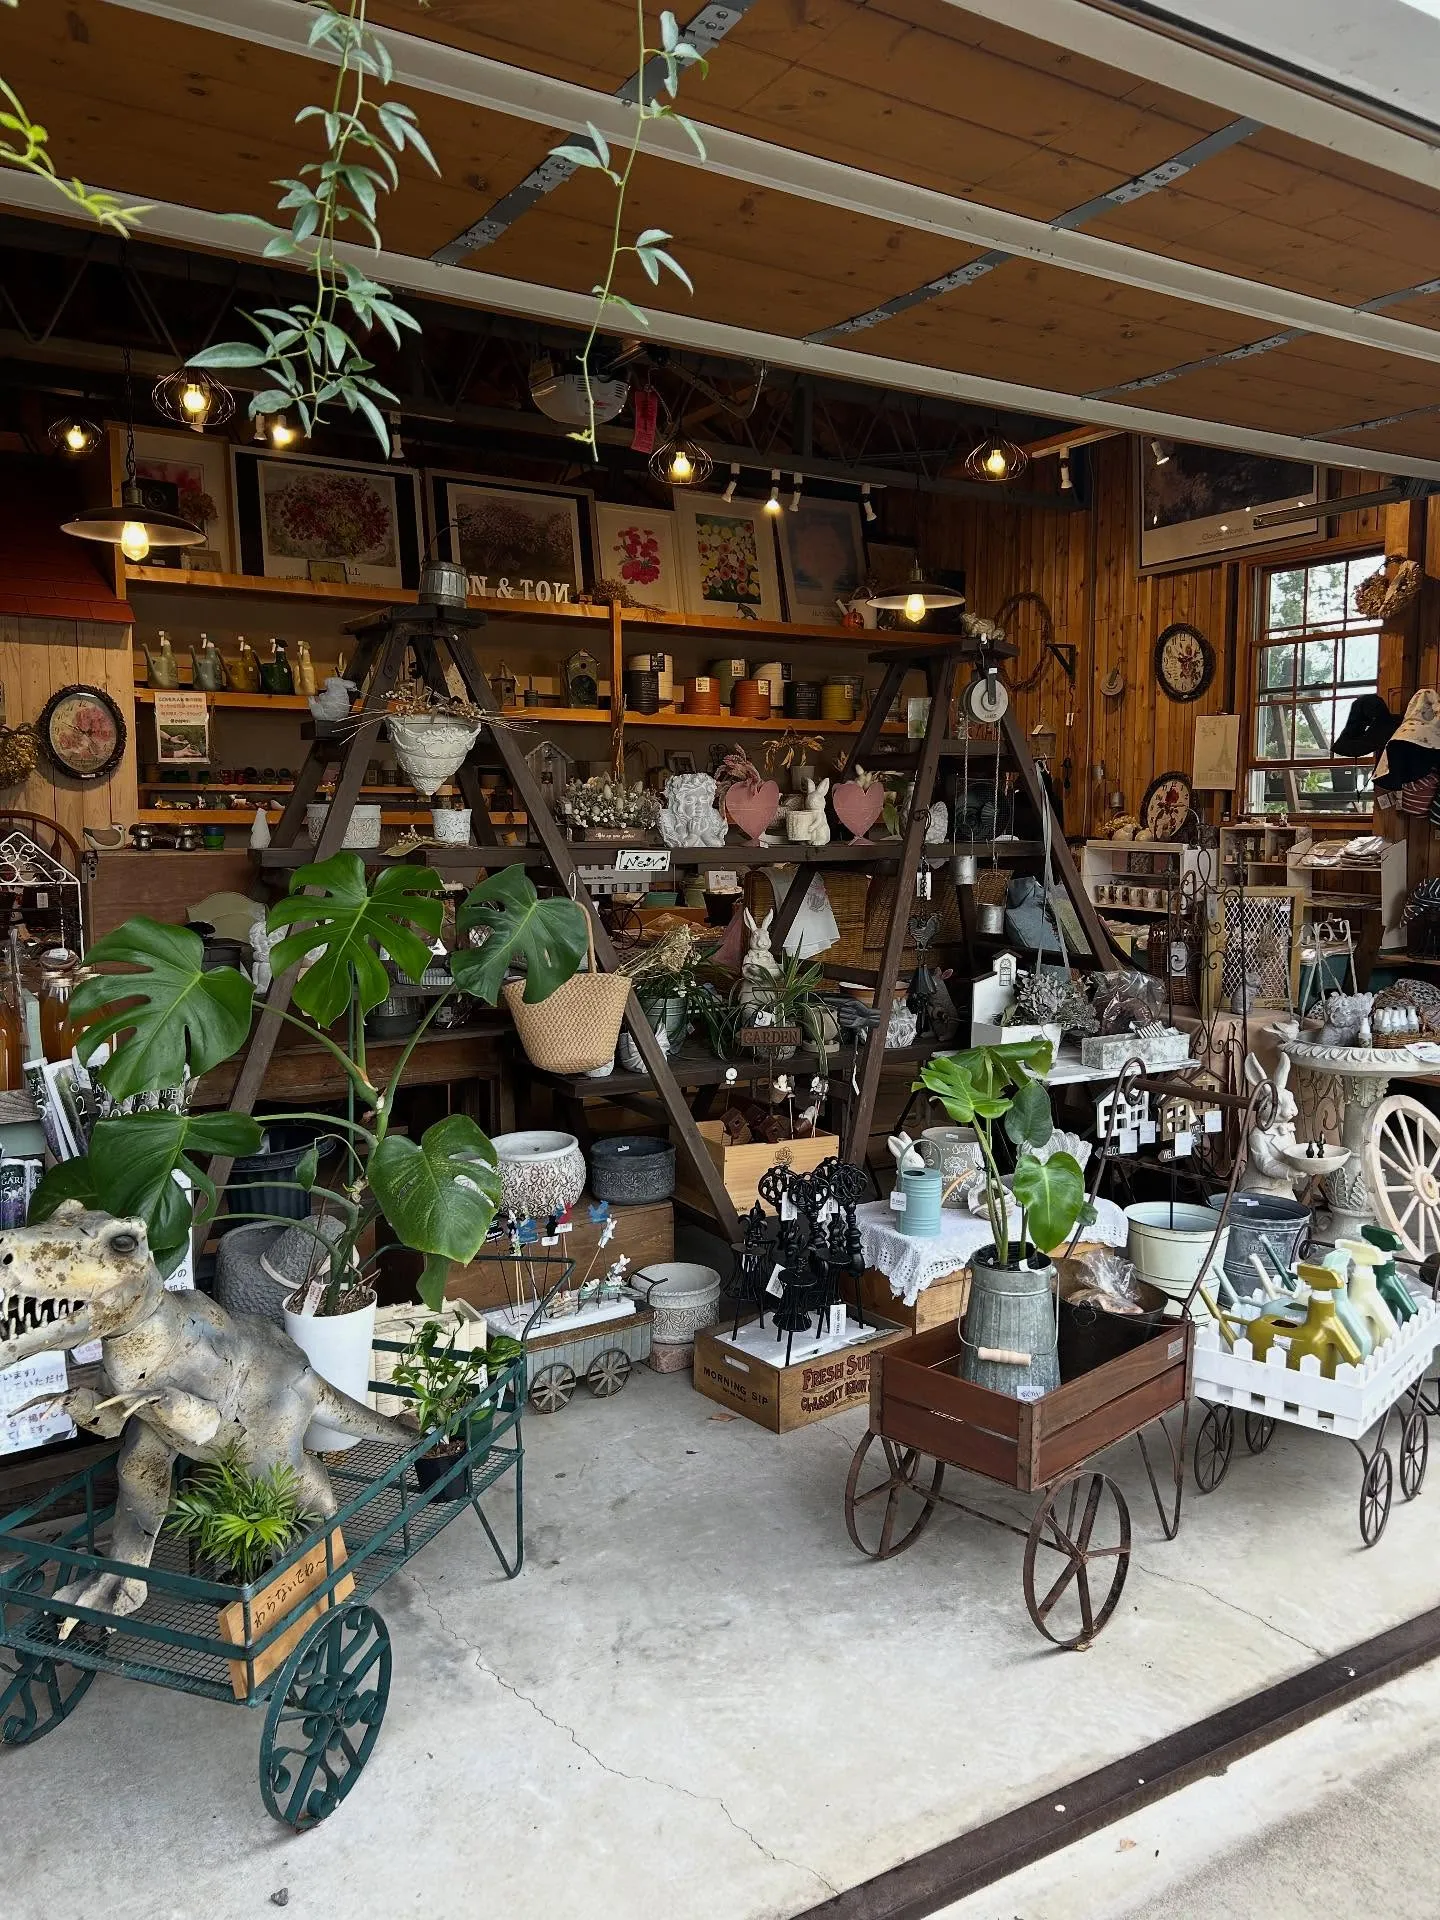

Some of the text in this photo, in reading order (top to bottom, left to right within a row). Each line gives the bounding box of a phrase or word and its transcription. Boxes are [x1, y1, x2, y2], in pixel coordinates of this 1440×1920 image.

[496, 578, 515, 599] &
[743, 1030, 799, 1045] GARDEN
[703, 1366, 747, 1396] MORNING
[751, 1392, 769, 1405] SIP
[802, 1361, 844, 1392] FRESH
